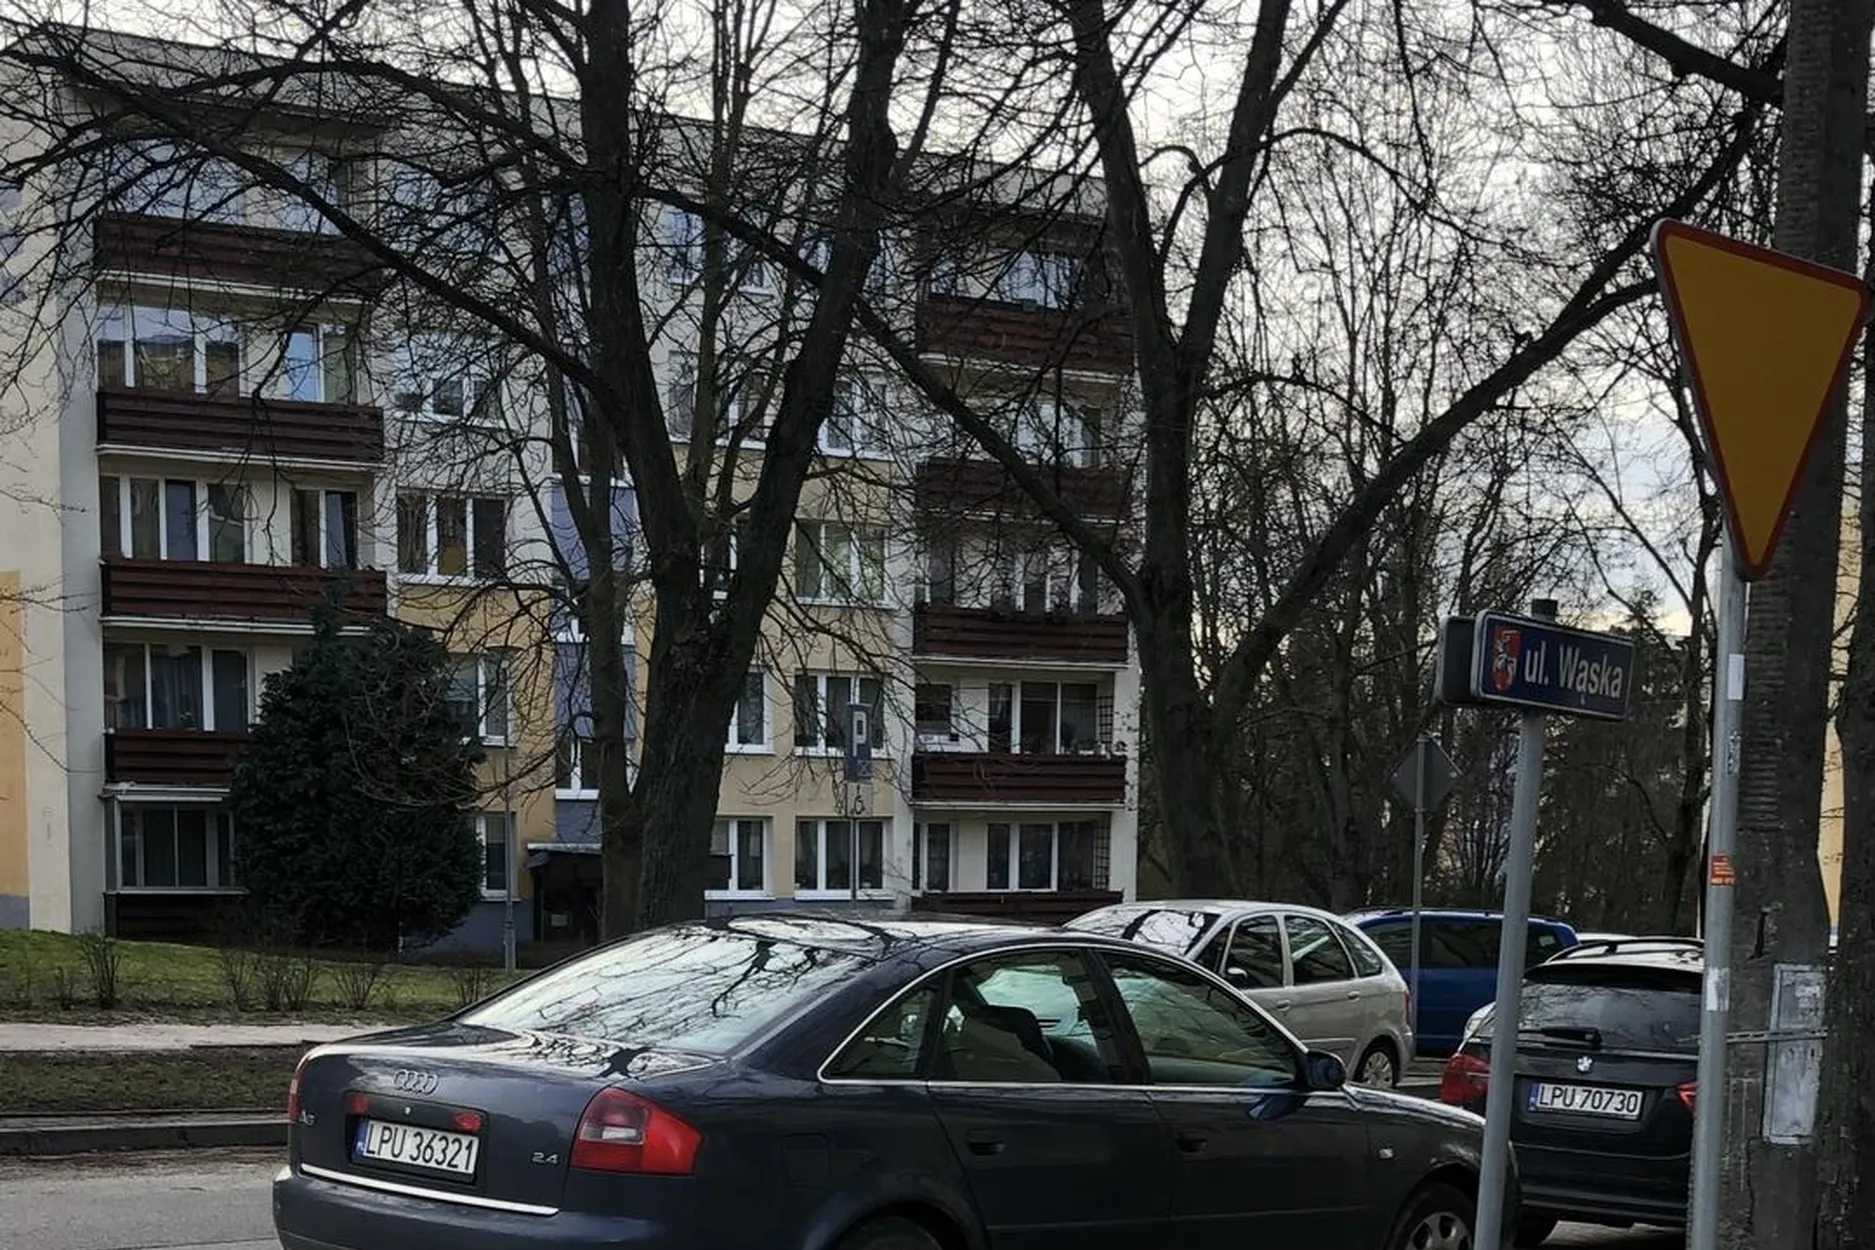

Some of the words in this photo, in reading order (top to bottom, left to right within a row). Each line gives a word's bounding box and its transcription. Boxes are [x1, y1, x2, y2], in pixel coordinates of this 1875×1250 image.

[1524, 640, 1549, 686] ul.
[852, 710, 867, 757] P
[1539, 1085, 1576, 1108] LPU
[1580, 1088, 1639, 1114] 70730
[366, 1123, 407, 1159] LPU
[409, 1130, 474, 1171] 36321
